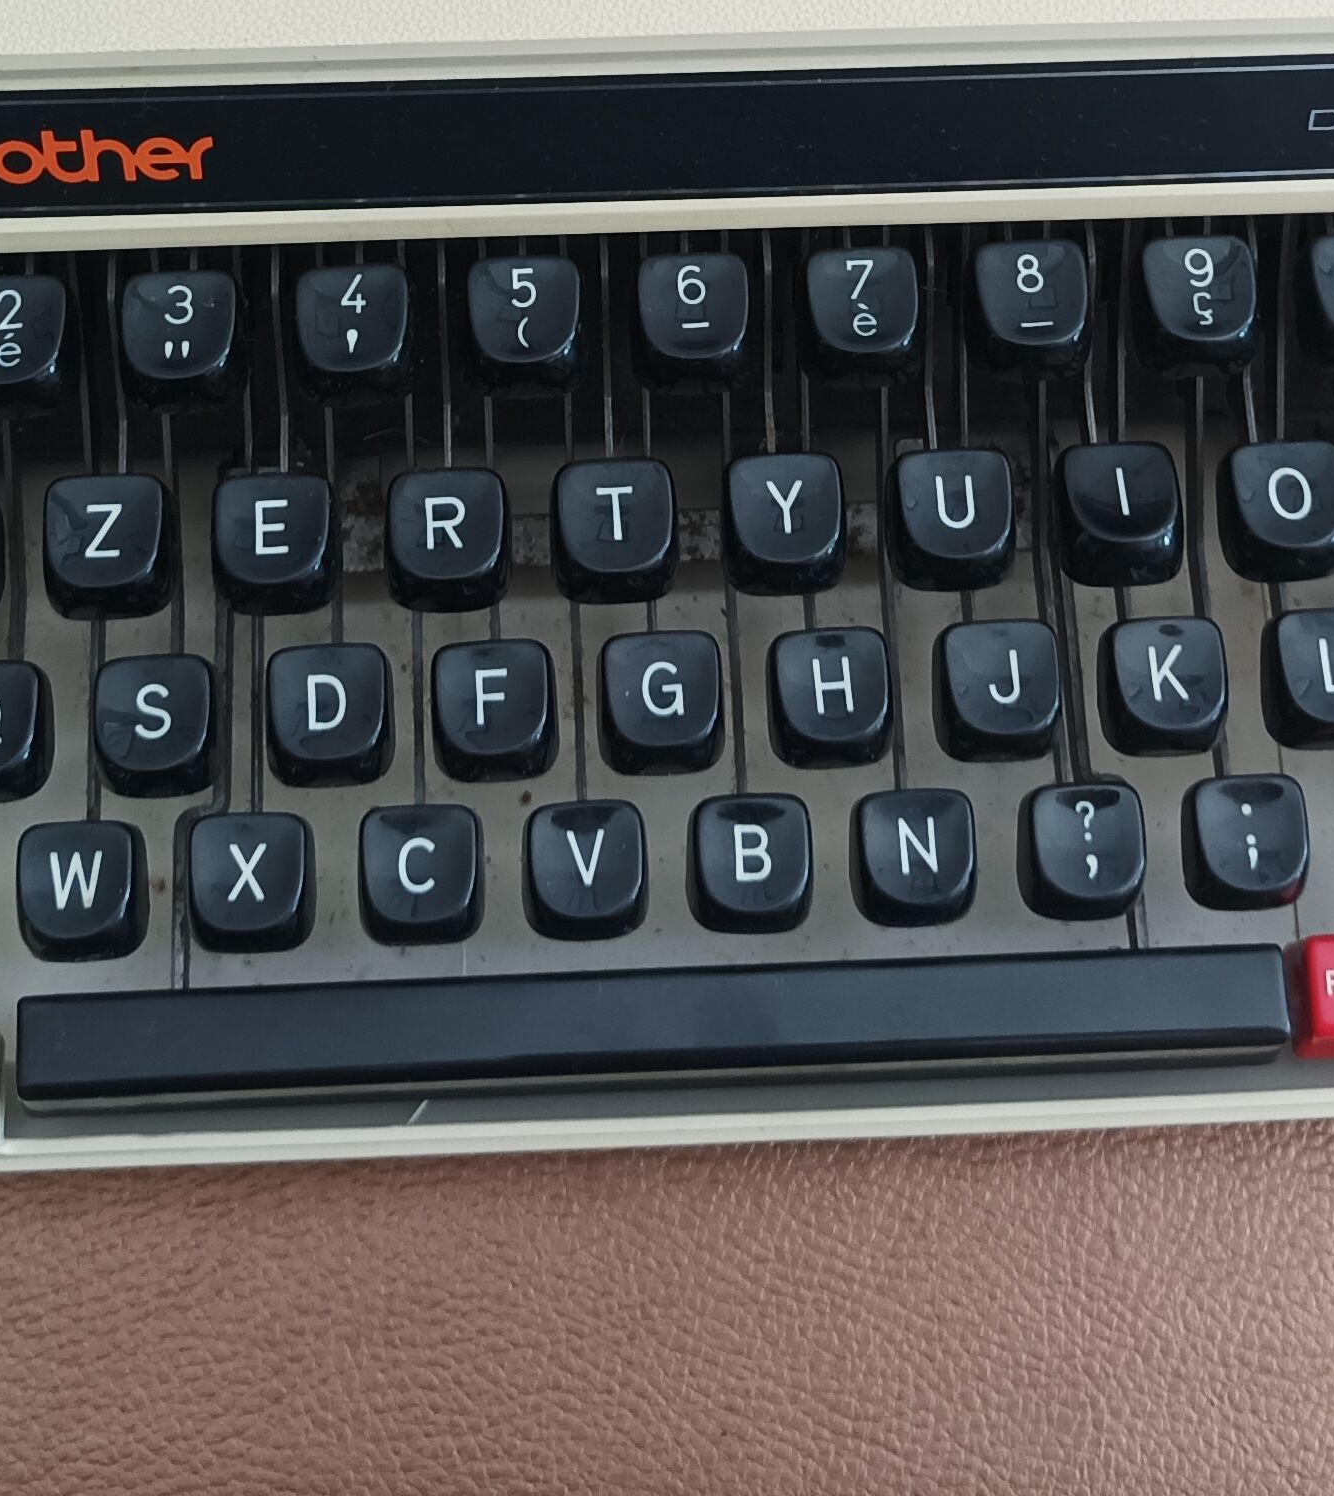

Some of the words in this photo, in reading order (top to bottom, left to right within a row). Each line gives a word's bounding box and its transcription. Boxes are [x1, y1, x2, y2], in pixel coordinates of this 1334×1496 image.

[340, 273, 367, 314] 4
[511, 267, 537, 308] 5
[677, 265, 706, 305] 6
[846, 259, 874, 300] 7
[1016, 253, 1044, 293] 8
[1184, 248, 1214, 288] 9
[164, 284, 194, 325] 3
[852, 302, 878, 337] è
[1192, 291, 1213, 325] ç
[517, 317, 529, 348] (
[595, 485, 633, 541] T
[765, 479, 803, 534] Y
[935, 474, 975, 529] U
[1115, 467, 1130, 516] I
[1268, 467, 1312, 520] O
[84, 503, 123, 558] Z
[254, 499, 289, 555] E
[424, 496, 466, 550] R
[475, 667, 508, 726] F
[641, 661, 685, 716] G
[812, 656, 854, 714] H
[988, 649, 1021, 704] J
[1148, 644, 1189, 702] K
[134, 683, 172, 739] S
[306, 674, 347, 731] D
[897, 816, 938, 875] N
[1075, 800, 1095, 842] ?
[227, 842, 267, 902] X
[398, 837, 436, 893] C
[566, 828, 605, 886] V
[733, 823, 772, 882] B
[1246, 834, 1258, 869] ;
[49, 850, 103, 910] W
